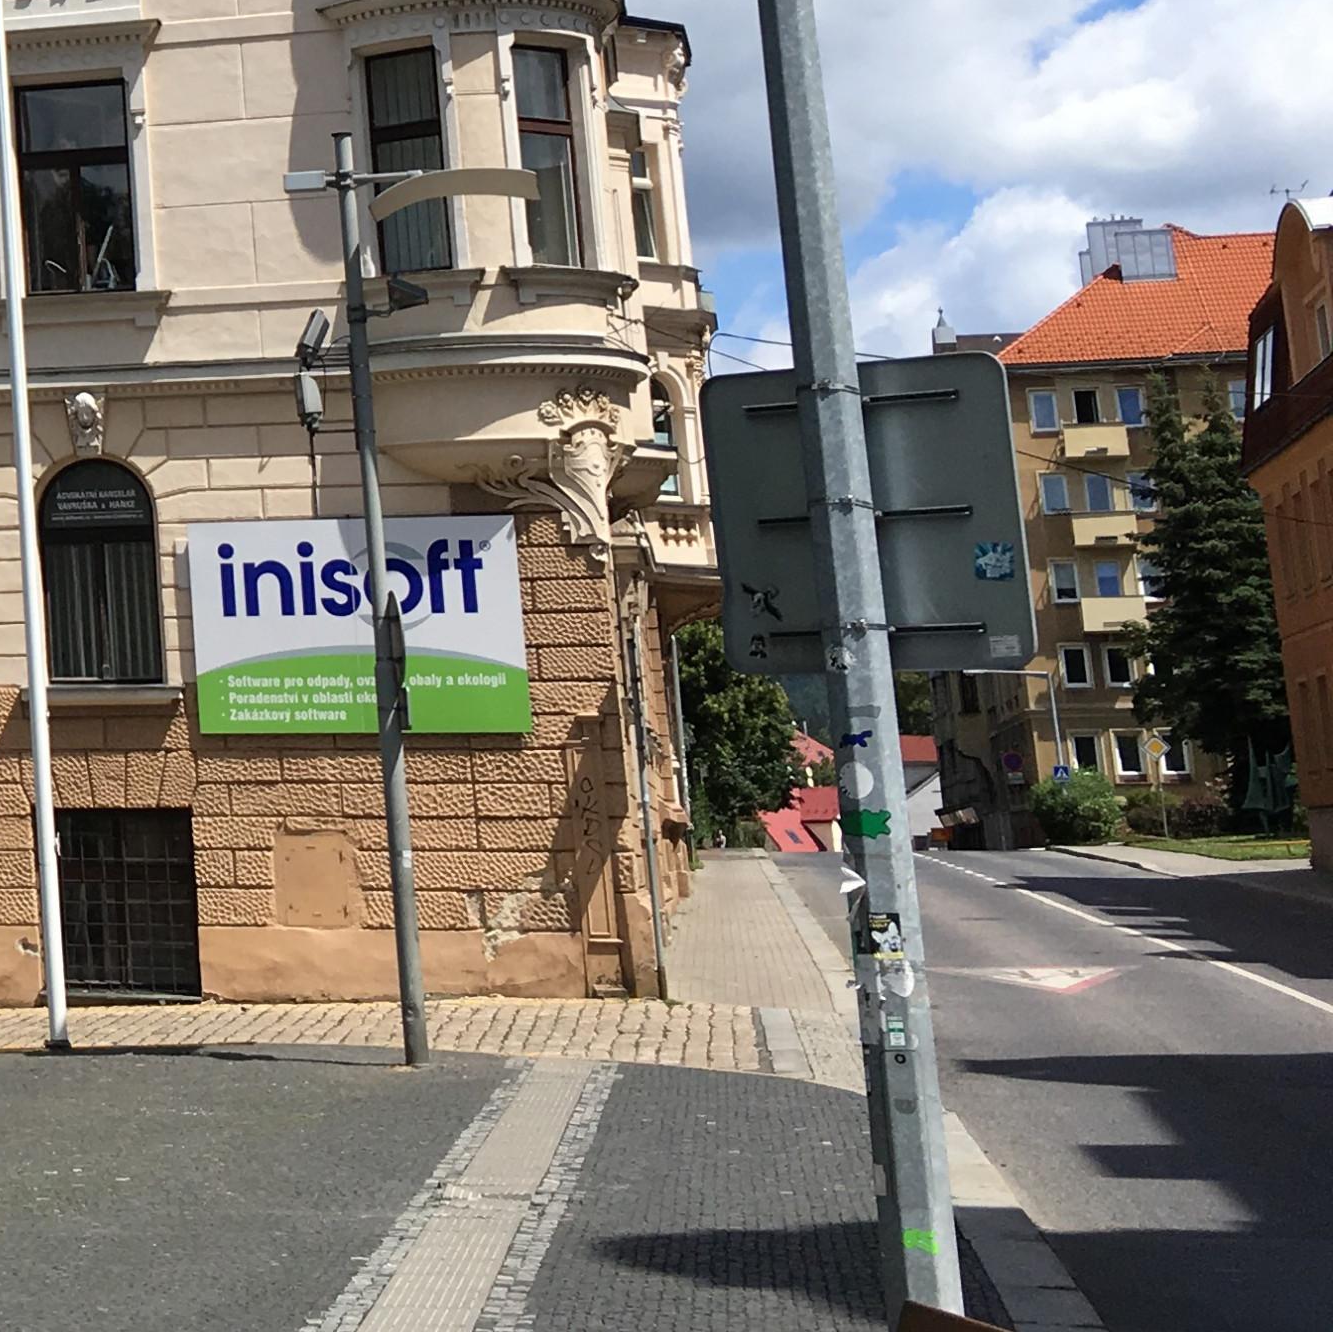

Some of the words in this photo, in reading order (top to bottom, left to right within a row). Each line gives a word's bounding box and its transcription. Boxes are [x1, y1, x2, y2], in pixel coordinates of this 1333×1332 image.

[217, 539, 483, 617] inisoft
[228, 675, 280, 688] Software
[284, 679, 304, 689] pro
[307, 674, 353, 689] odpady,
[409, 673, 442, 688] obaly
[446, 675, 454, 686] a
[457, 672, 506, 688] ekologii
[229, 692, 299, 704] Poradenství
[302, 694, 309, 704] v
[312, 692, 353, 704] oblasti
[229, 708, 291, 722] Zakázkový
[294, 708, 347, 721] software
